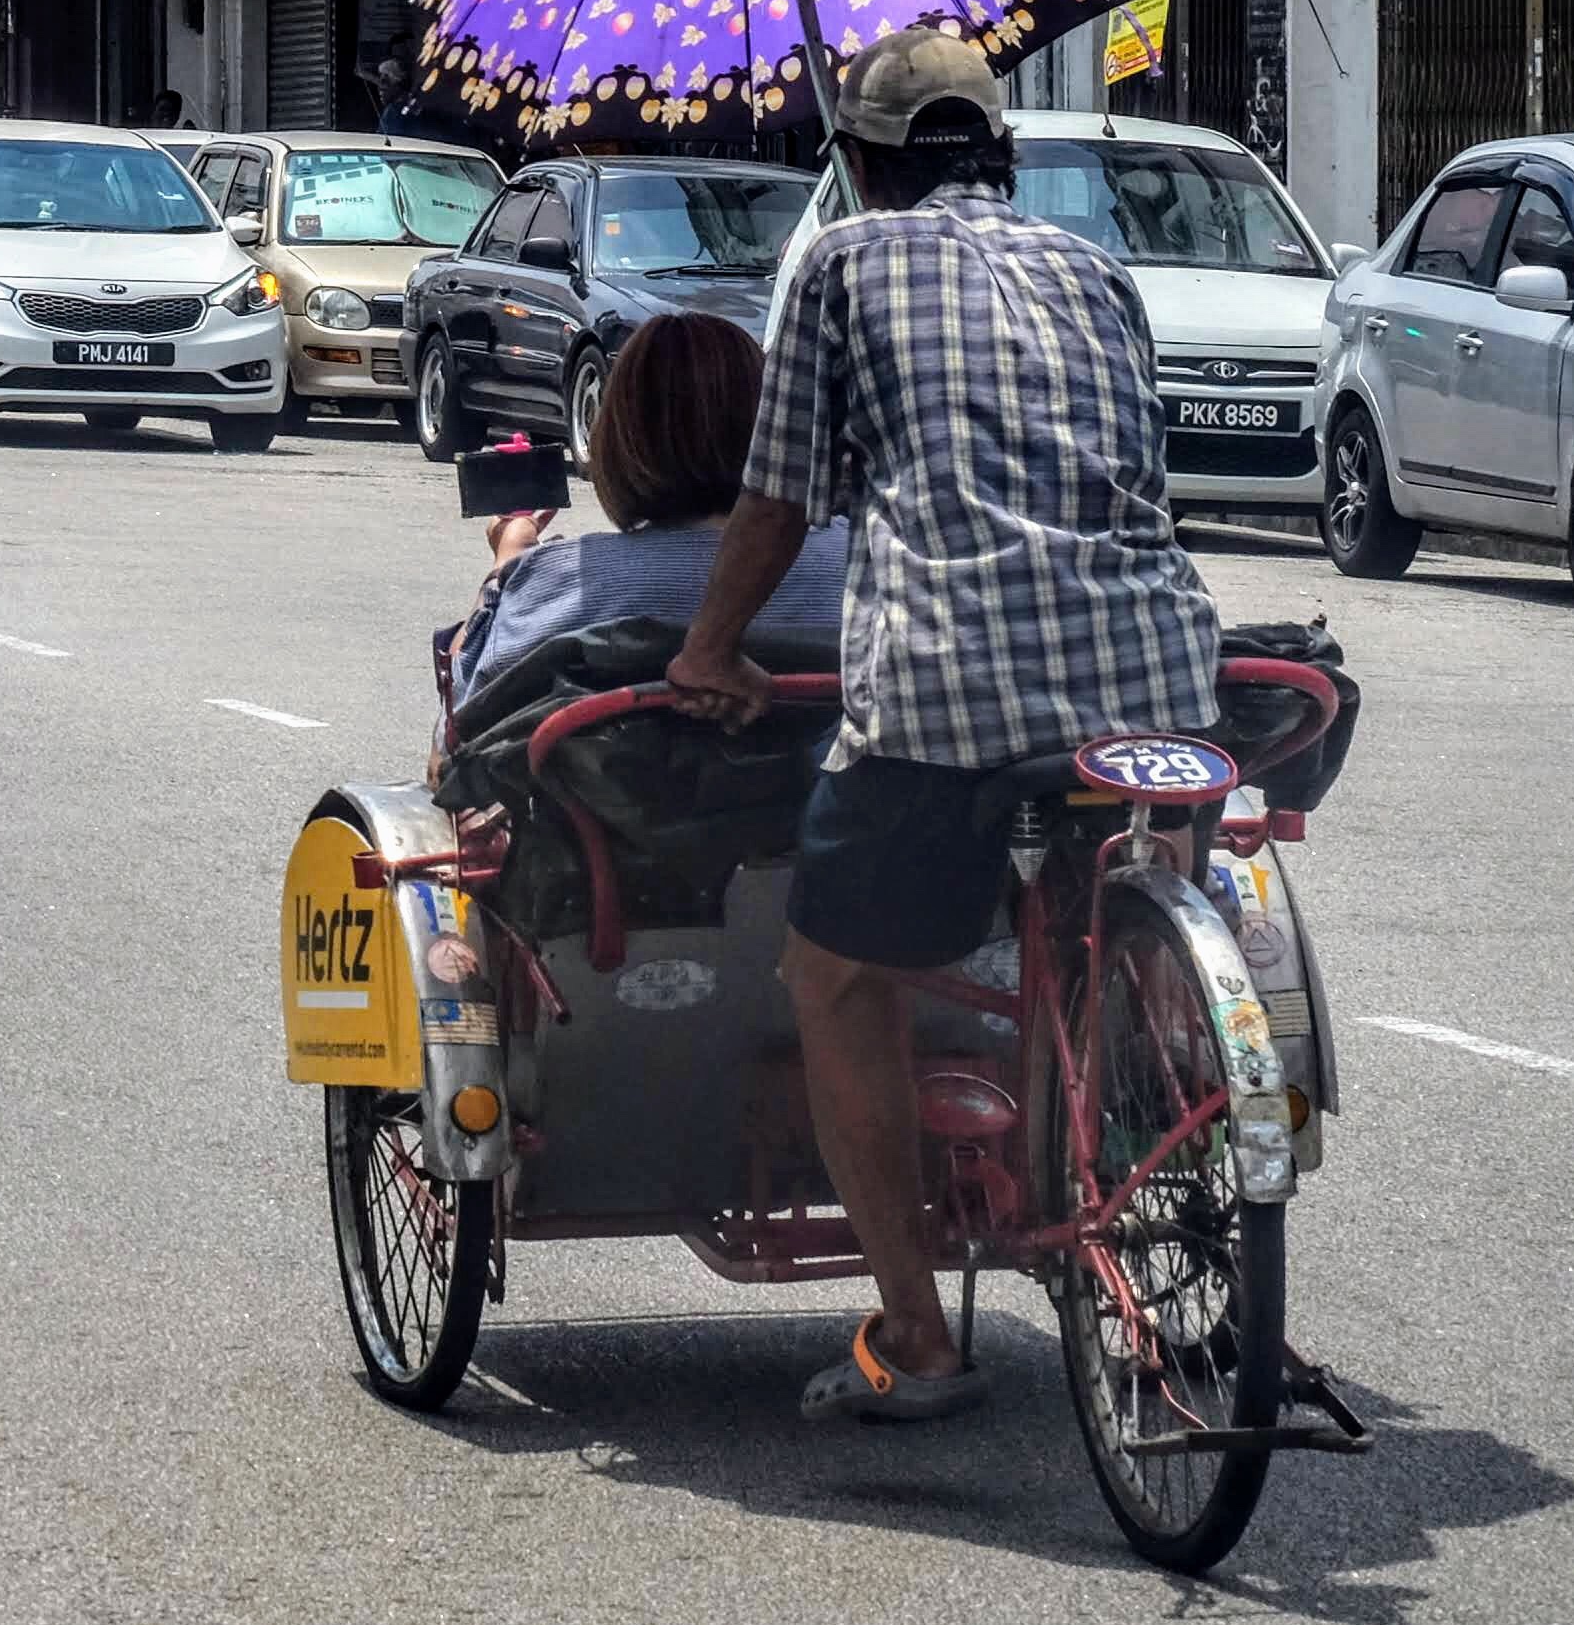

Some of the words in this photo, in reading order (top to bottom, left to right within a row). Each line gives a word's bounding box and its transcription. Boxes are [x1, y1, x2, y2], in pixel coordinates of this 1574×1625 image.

[78, 343, 112, 363] PMJ
[115, 344, 149, 363] 4141
[1179, 401, 1222, 425] PKK
[1224, 403, 1278, 427] 8569
[1103, 752, 1212, 786] 729
[295, 893, 374, 984] Hertz
